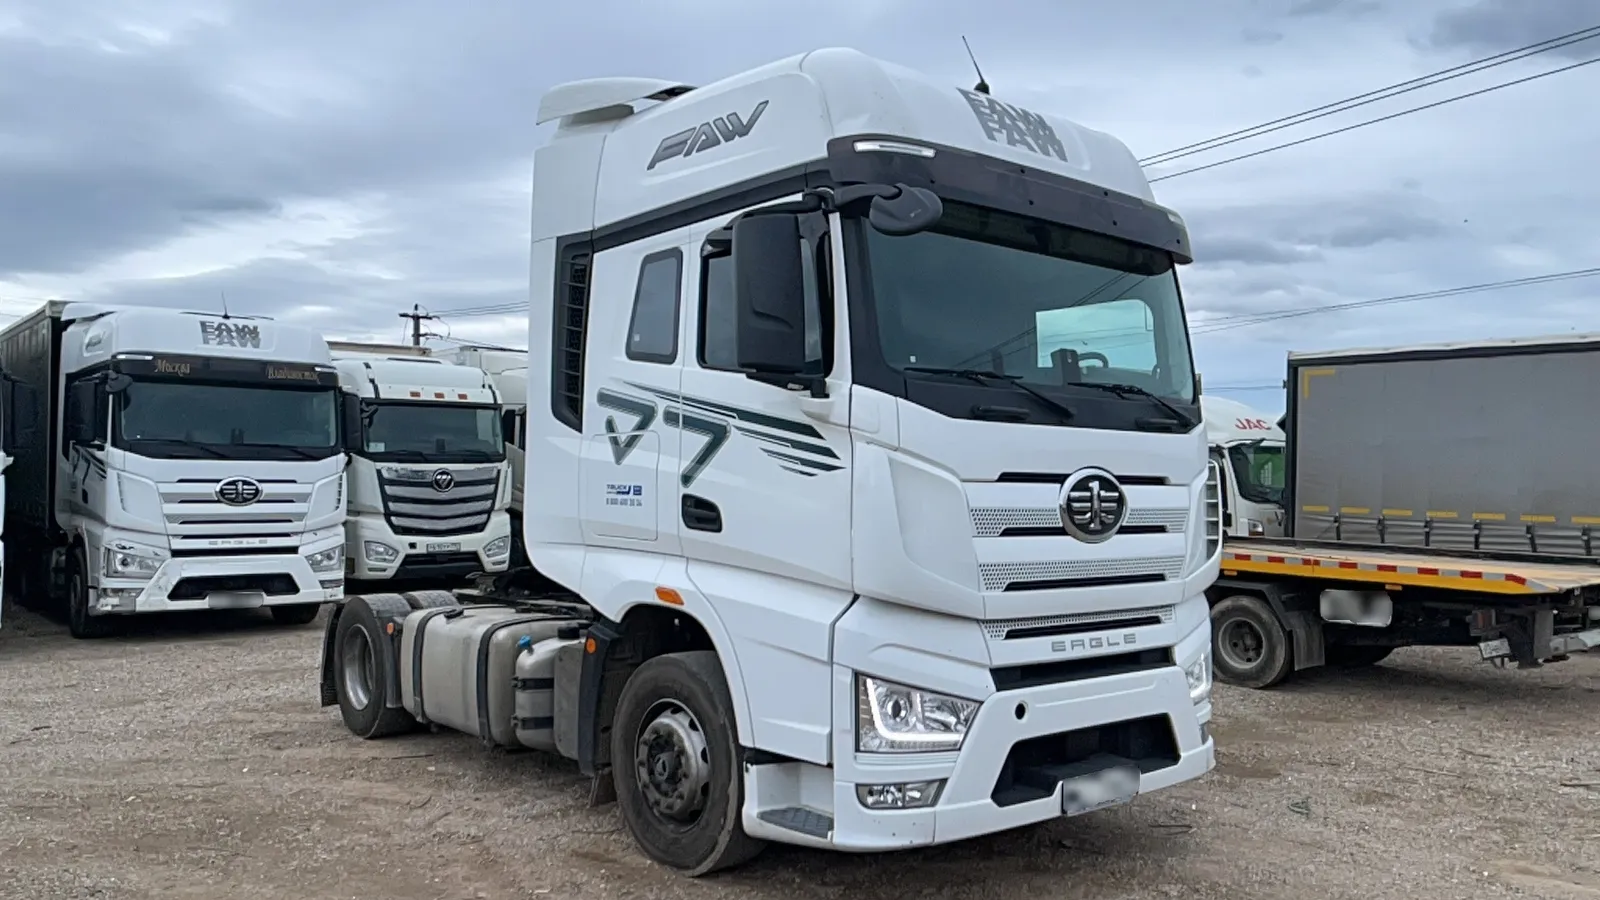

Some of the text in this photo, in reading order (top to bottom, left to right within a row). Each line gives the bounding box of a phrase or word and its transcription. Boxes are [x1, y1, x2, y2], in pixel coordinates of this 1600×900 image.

[646, 99, 769, 171] FAW
[1235, 417, 1272, 430] JAC
[1051, 632, 1137, 653] EAGLE
